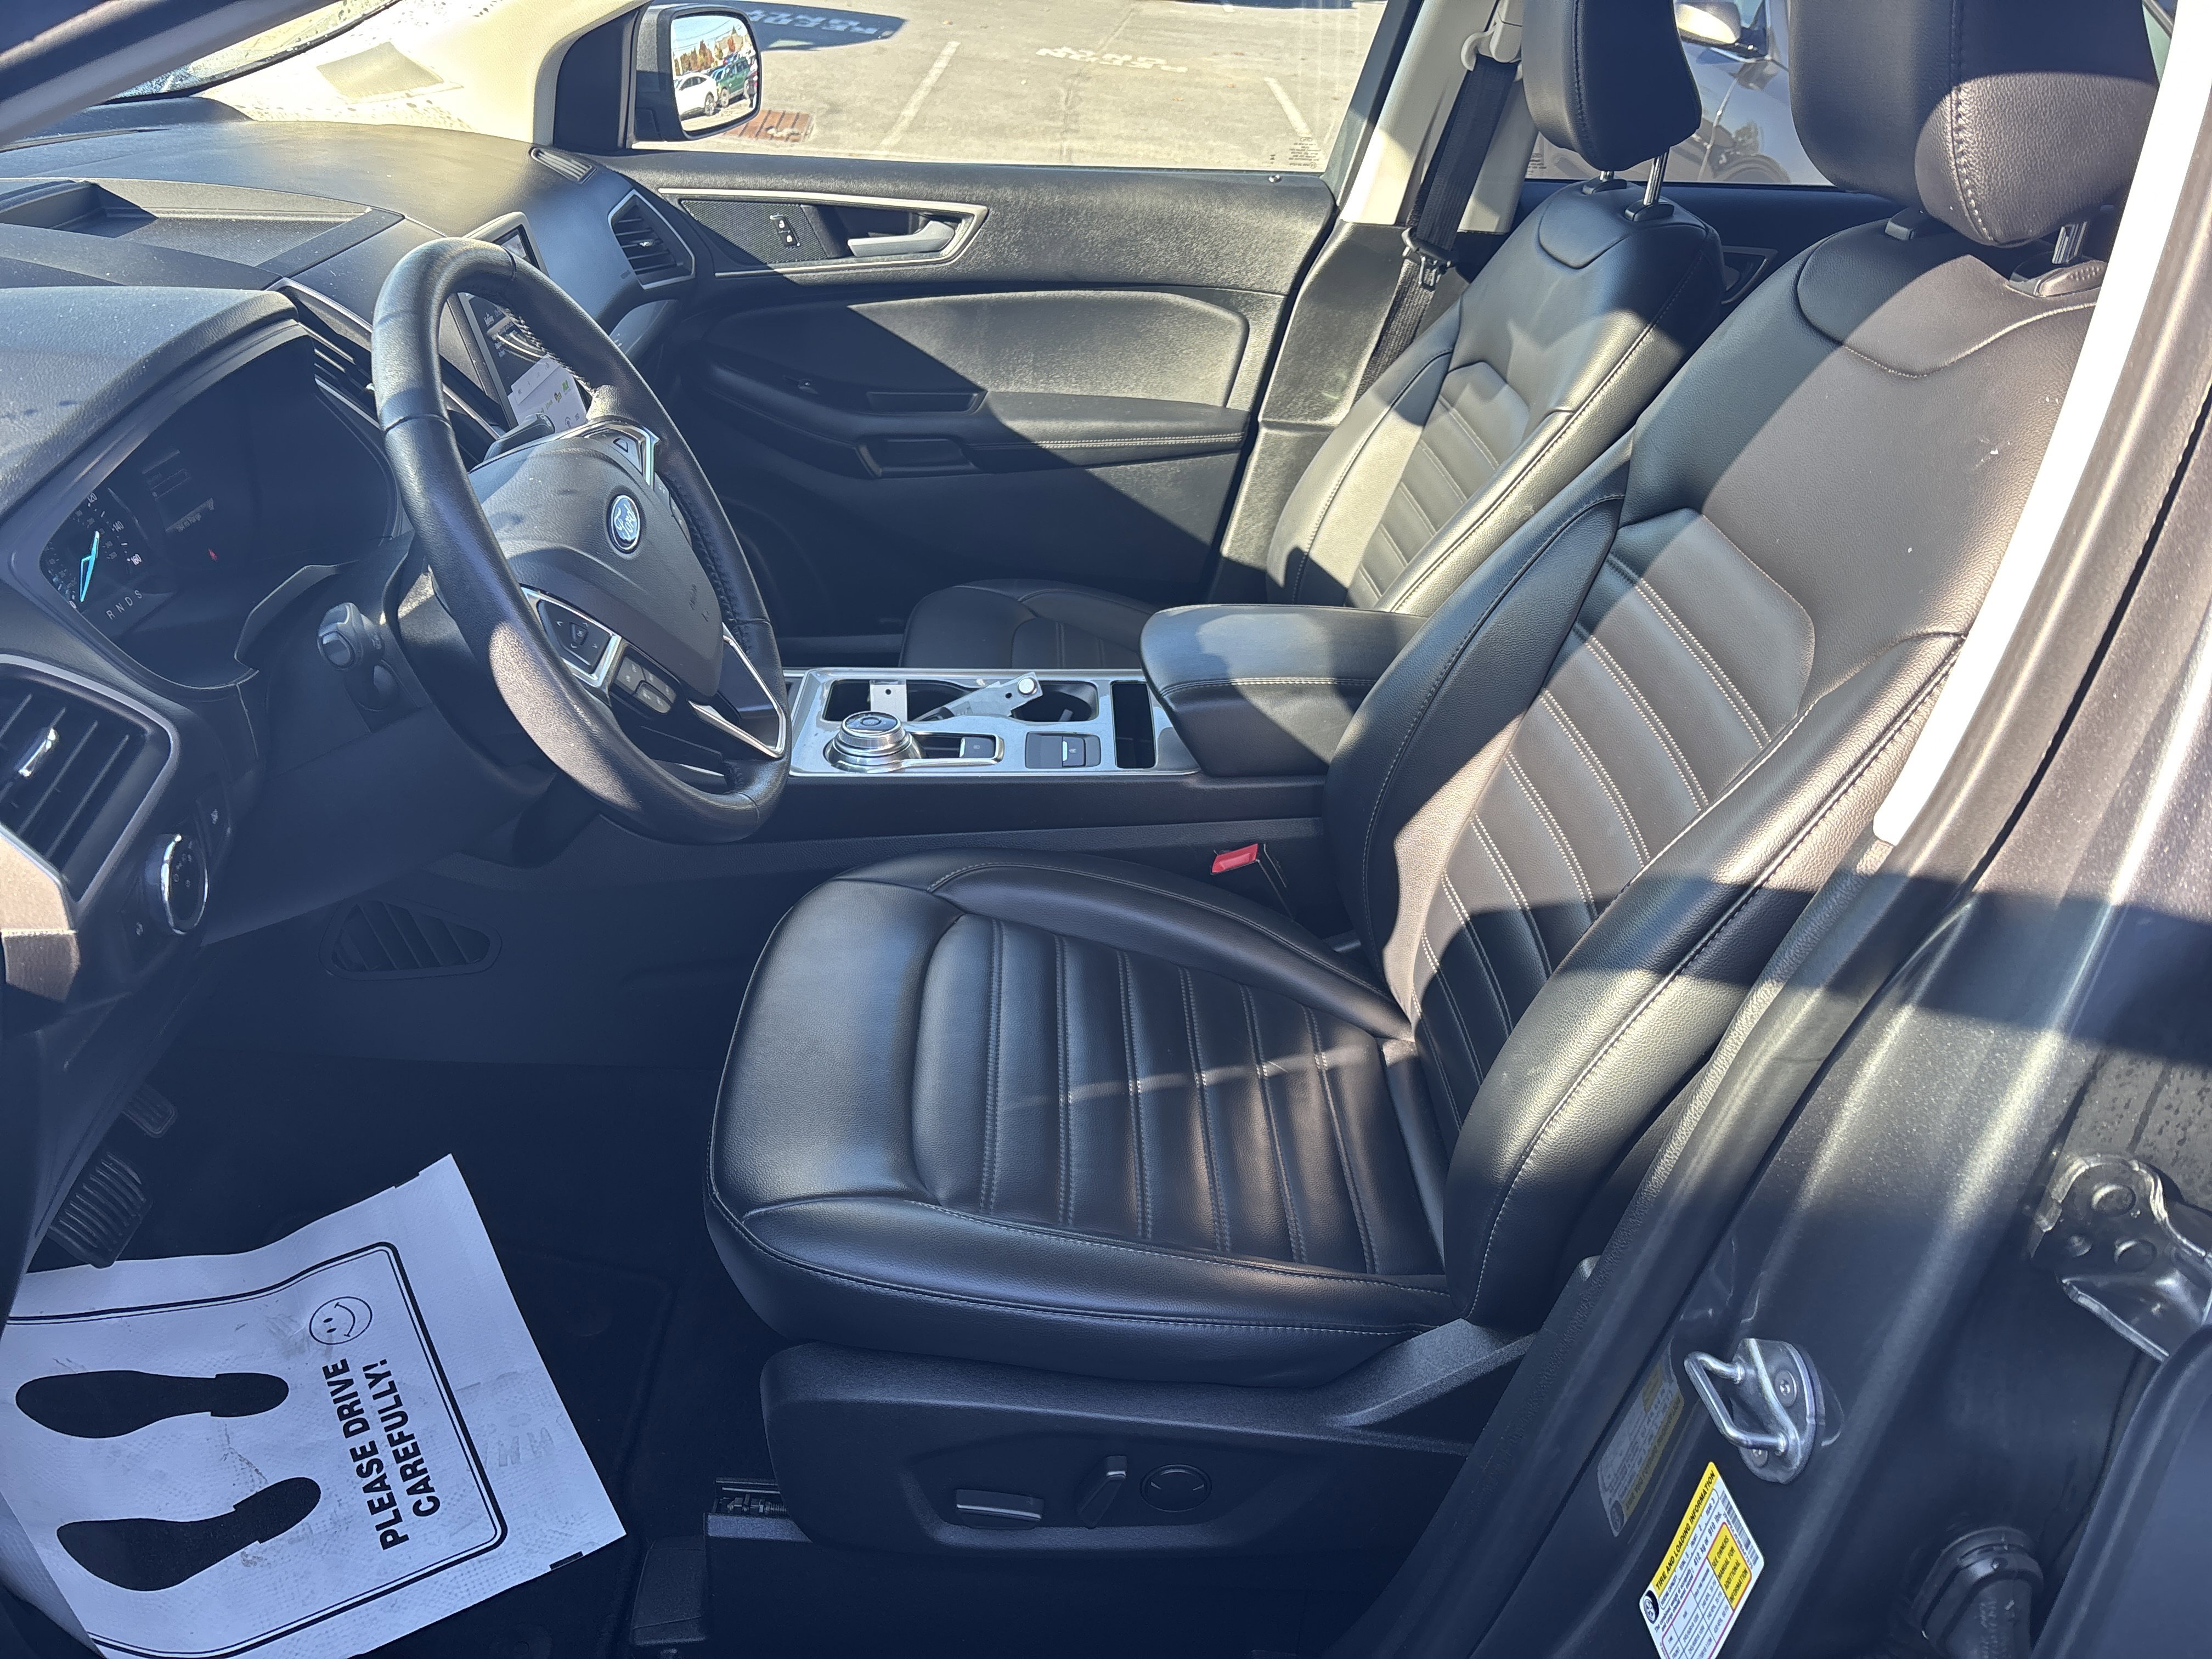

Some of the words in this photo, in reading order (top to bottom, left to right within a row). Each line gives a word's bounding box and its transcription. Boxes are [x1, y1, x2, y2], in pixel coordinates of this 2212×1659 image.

[86, 492, 98, 503] 120
[113, 520, 125, 532] 140
[613, 503, 637, 540] Ford
[131, 554, 142, 566] 160
[106, 610, 116, 620] R
[115, 602, 125, 613] N
[125, 596, 133, 606] D
[134, 590, 143, 599] S
[321, 1358, 371, 1438] DRIVE
[362, 1358, 441, 1517] CAREFULLY!
[349, 1440, 409, 1550] PLEASE
[1656, 1571, 1667, 1590] TIRE
[1666, 1555, 1674, 1573] AND
[1673, 1523, 1690, 1557] LOADING
[1689, 1471, 1714, 1523] INFORMATION
[1717, 1536, 1729, 1559] OWNERS
[1717, 1558, 1729, 1580] MANUAL
[1724, 1560, 1740, 1590] ADDITIONAL
[1729, 1568, 1747, 1603] INFORMATION
